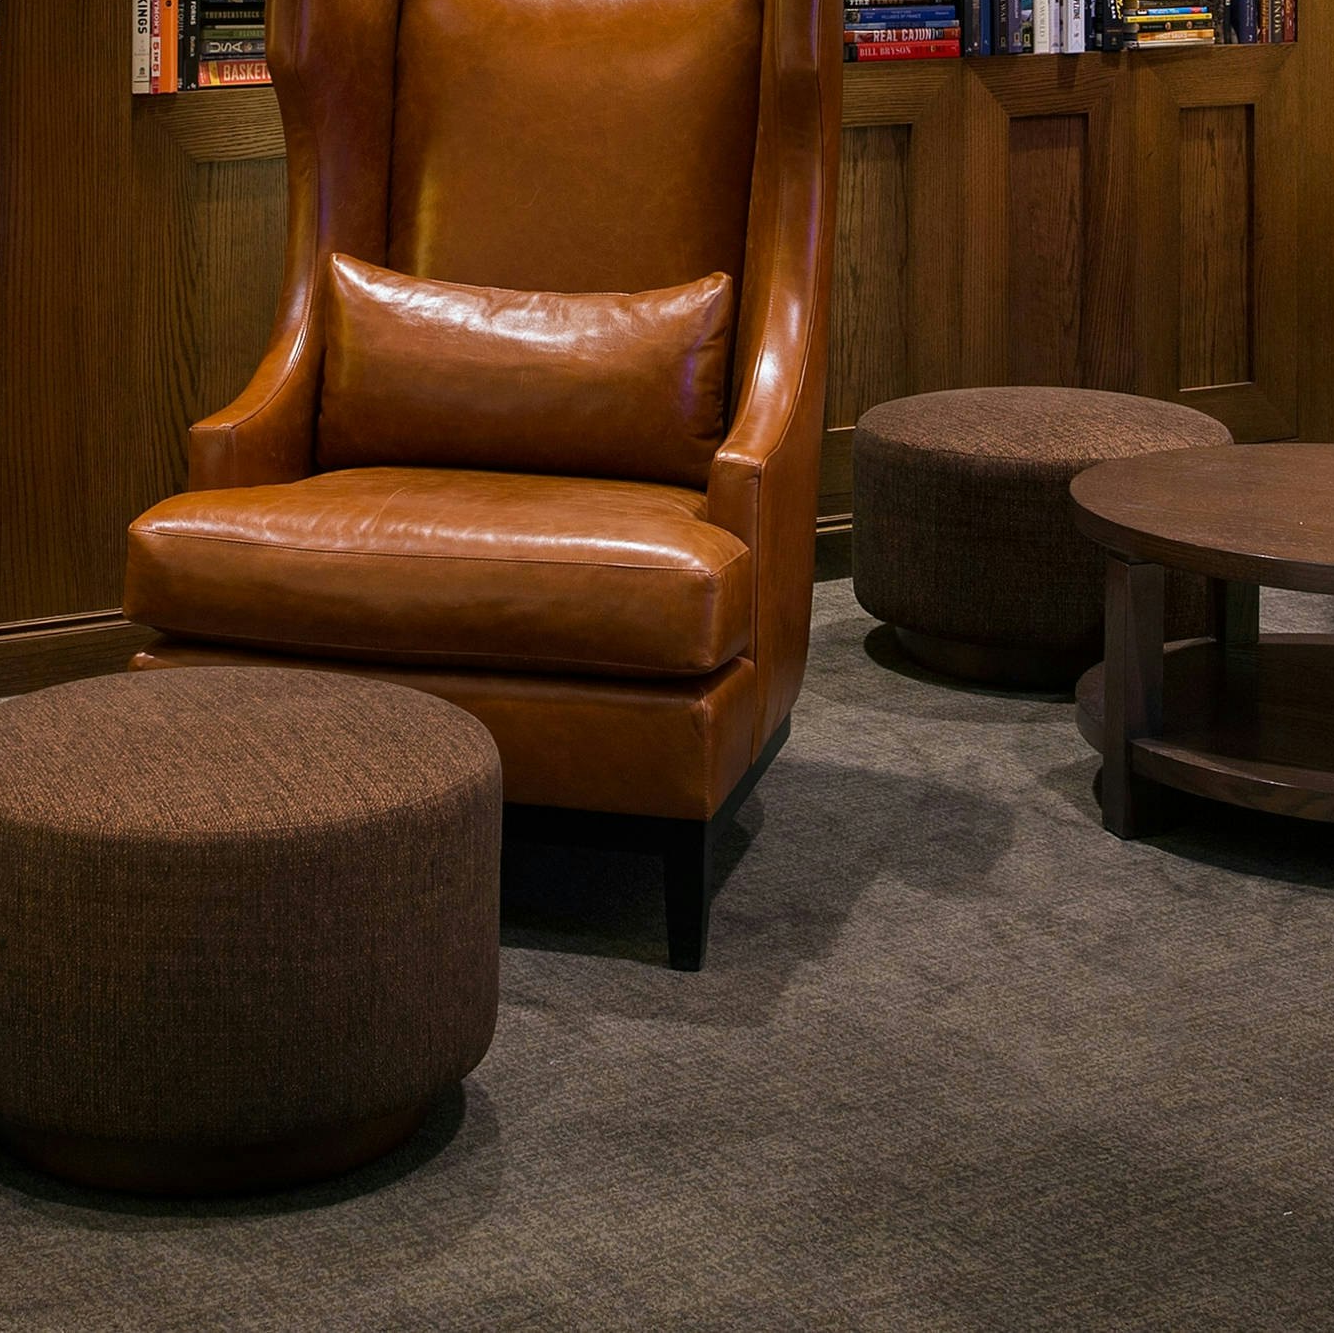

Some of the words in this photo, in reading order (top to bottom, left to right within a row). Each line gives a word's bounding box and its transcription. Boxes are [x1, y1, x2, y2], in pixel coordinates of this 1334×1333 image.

[873, 31, 898, 41] REAL
[902, 29, 931, 40] CAJUN
[859, 48, 877, 56] BILL
